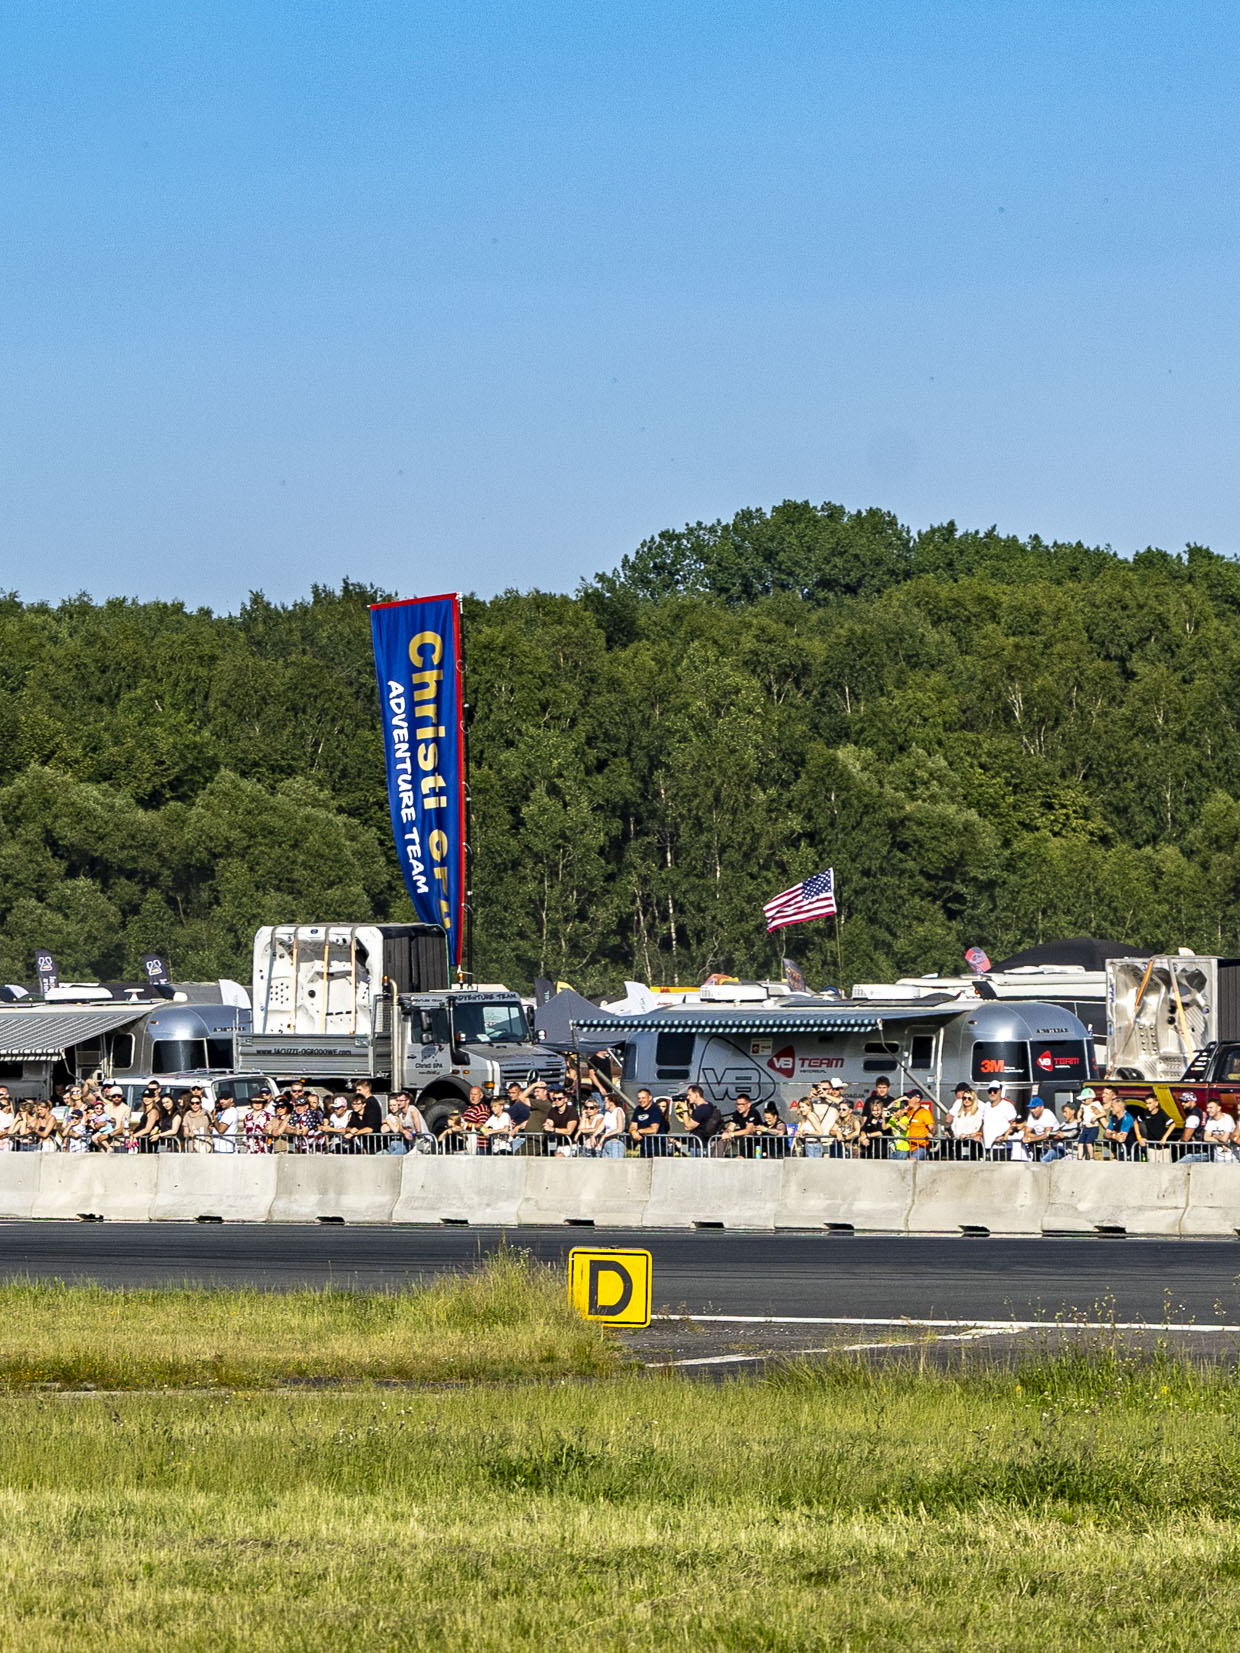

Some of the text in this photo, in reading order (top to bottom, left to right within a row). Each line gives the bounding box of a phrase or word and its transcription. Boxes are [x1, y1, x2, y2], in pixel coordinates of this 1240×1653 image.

[408, 630, 447, 810] Christi
[387, 679, 429, 895] ADVENTURE TEAM
[798, 1057, 845, 1068] TEAM
[980, 1058, 1005, 1073] 3M
[1053, 1057, 1080, 1065] TEAM
[588, 1259, 634, 1317] D
